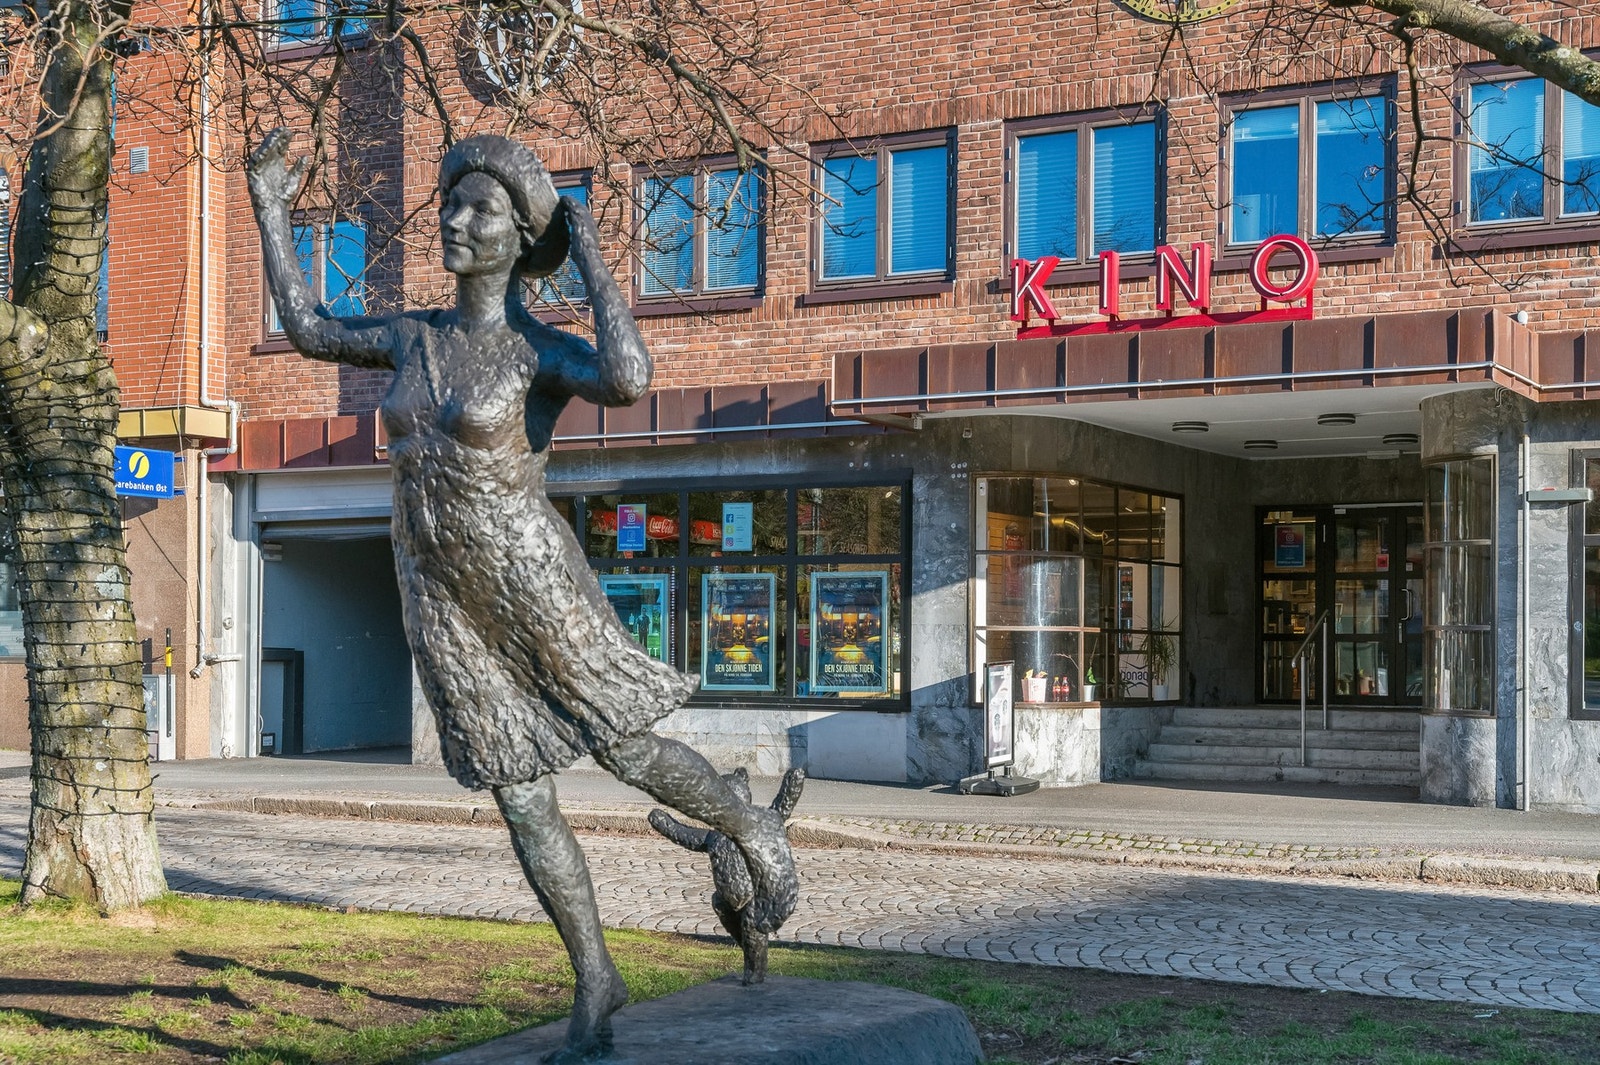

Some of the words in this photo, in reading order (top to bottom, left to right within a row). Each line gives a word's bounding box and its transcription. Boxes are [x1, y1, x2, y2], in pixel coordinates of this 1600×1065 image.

[1011, 234, 1319, 321] KINO
[155, 483, 168, 493] Øst
[714, 663, 725, 673] DEN
[725, 663, 747, 673] SKJØNNE
[748, 663, 763, 673] TIDEN
[824, 664, 835, 673] DEN
[859, 664, 875, 673] TIDEN
